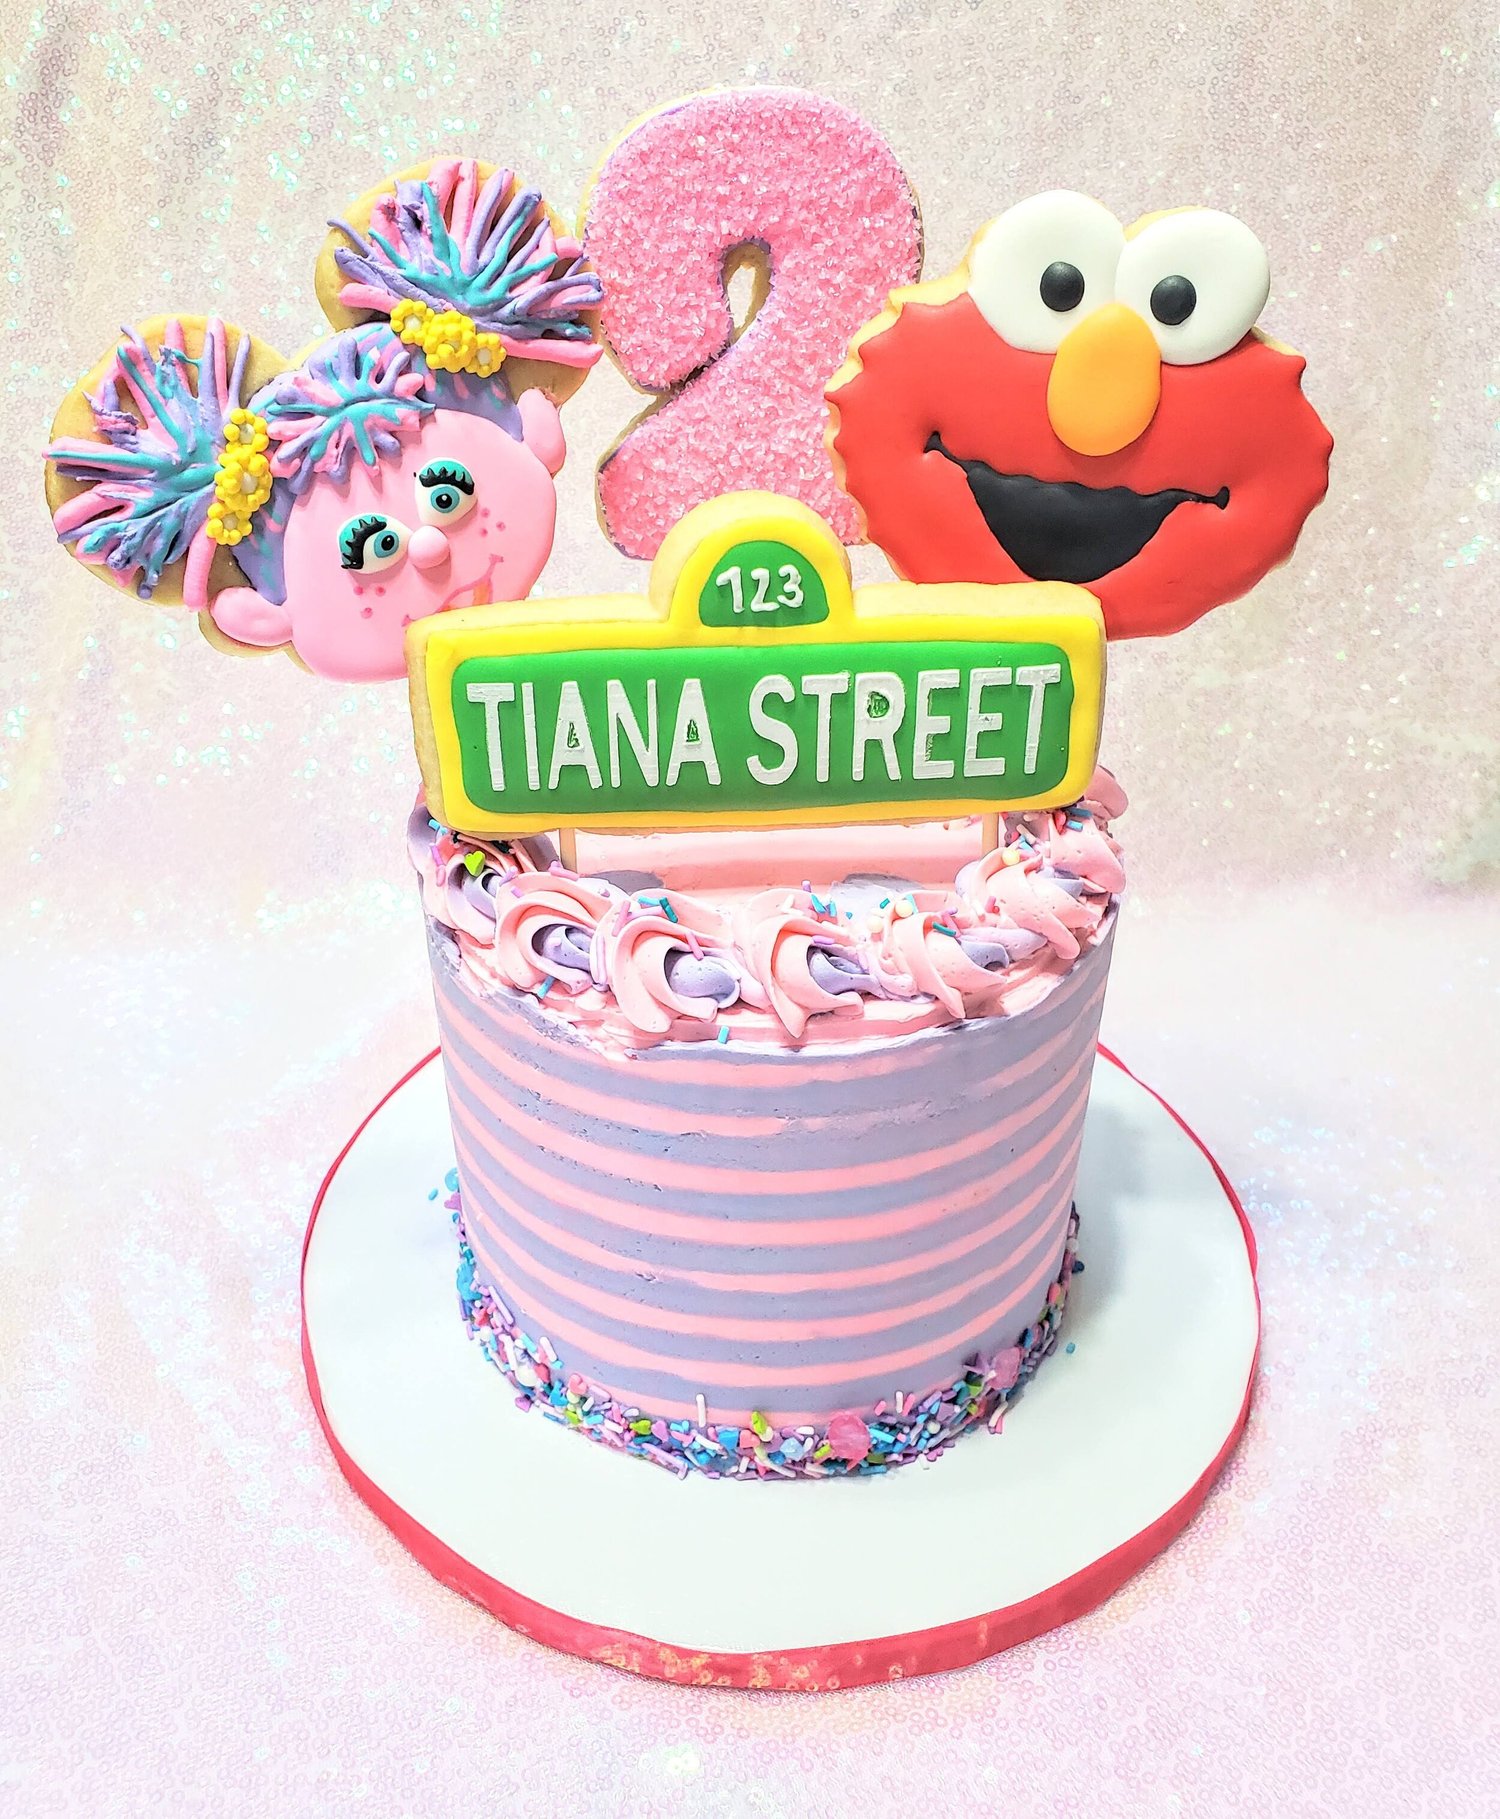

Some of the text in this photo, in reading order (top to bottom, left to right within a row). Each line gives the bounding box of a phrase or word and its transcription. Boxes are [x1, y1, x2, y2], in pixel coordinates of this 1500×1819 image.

[580, 85, 923, 560] 2
[716, 565, 804, 613] 123
[466, 663, 1061, 790] TIANA STREET
